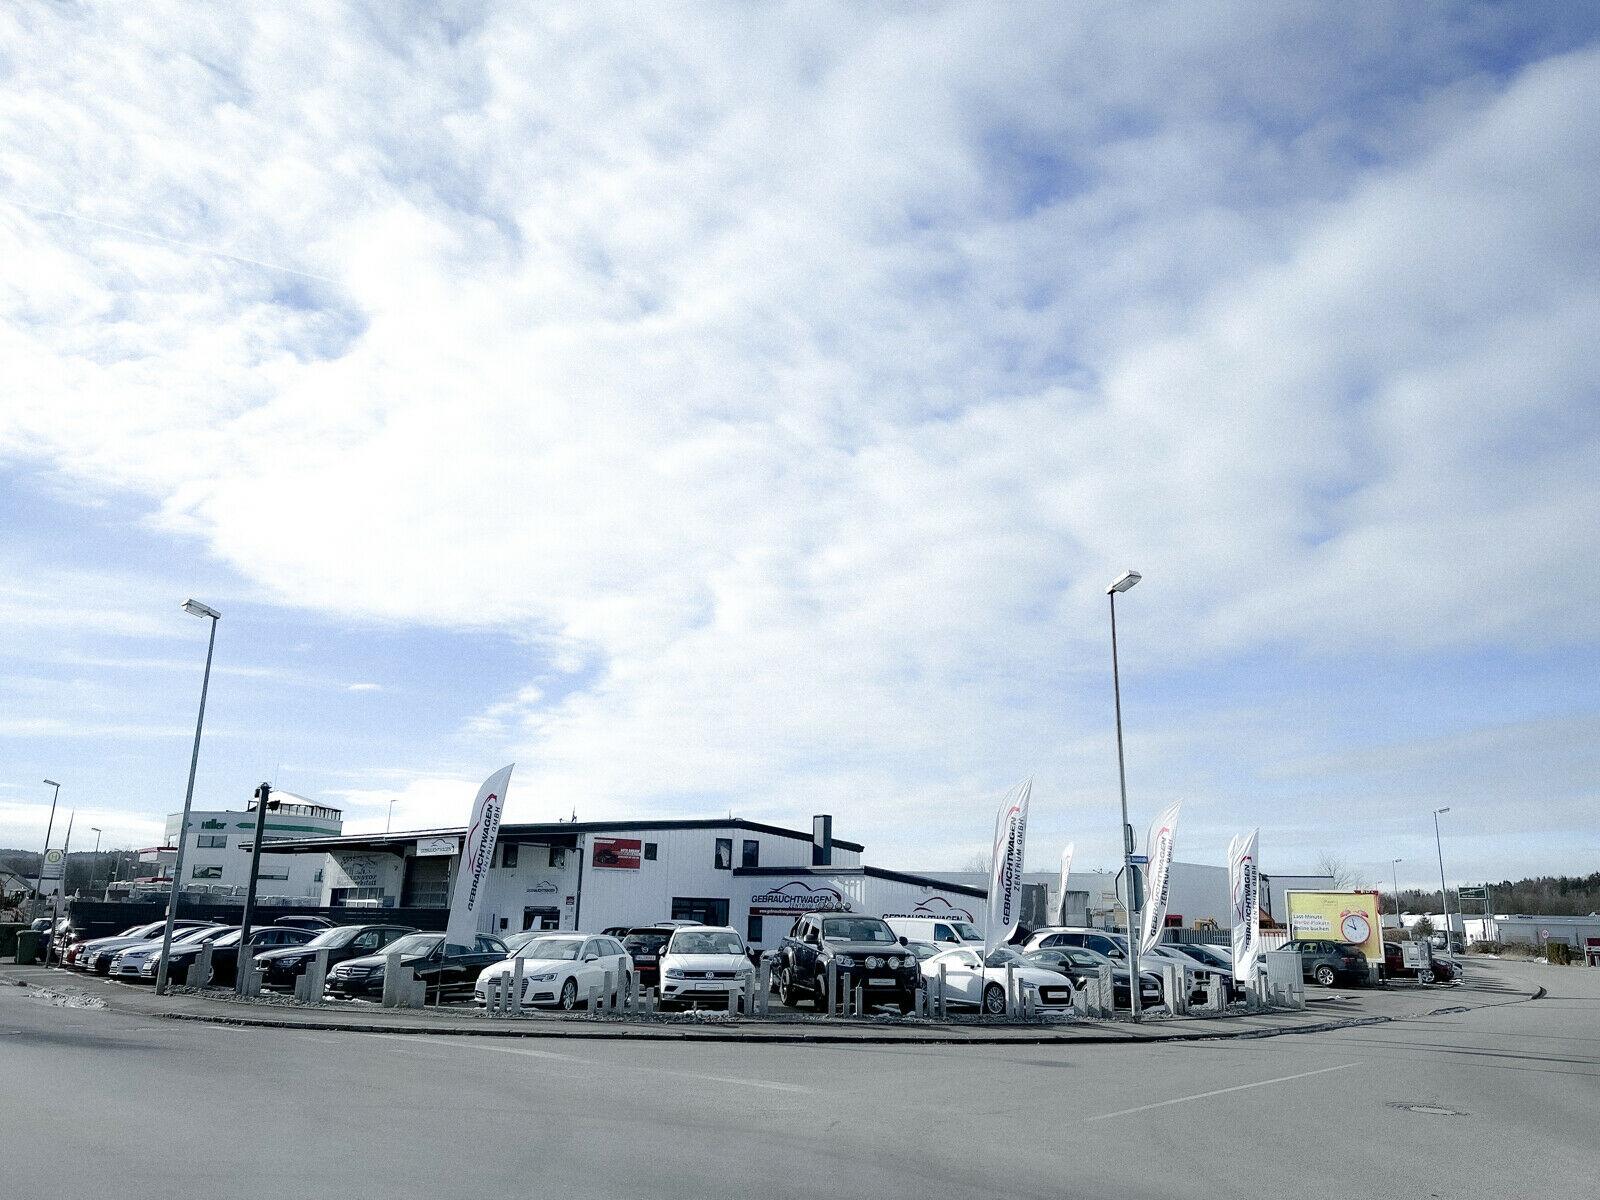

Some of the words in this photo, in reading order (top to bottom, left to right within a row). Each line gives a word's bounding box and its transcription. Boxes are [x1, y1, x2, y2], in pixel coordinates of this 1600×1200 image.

[201, 819, 227, 829] Hiller
[1016, 817, 1025, 845] GMBH
[468, 804, 494, 911] GEBRAUCHTWAGEN
[1003, 817, 1017, 926] GEBRAUCHTWAGEN
[1014, 849, 1022, 892] ZENTRUM
[751, 895, 832, 904] GEBRAUCHTWAGEN
[1150, 837, 1167, 937] GEBRAUCHTWAGEN
[1160, 867, 1171, 907] ZENTRUM
